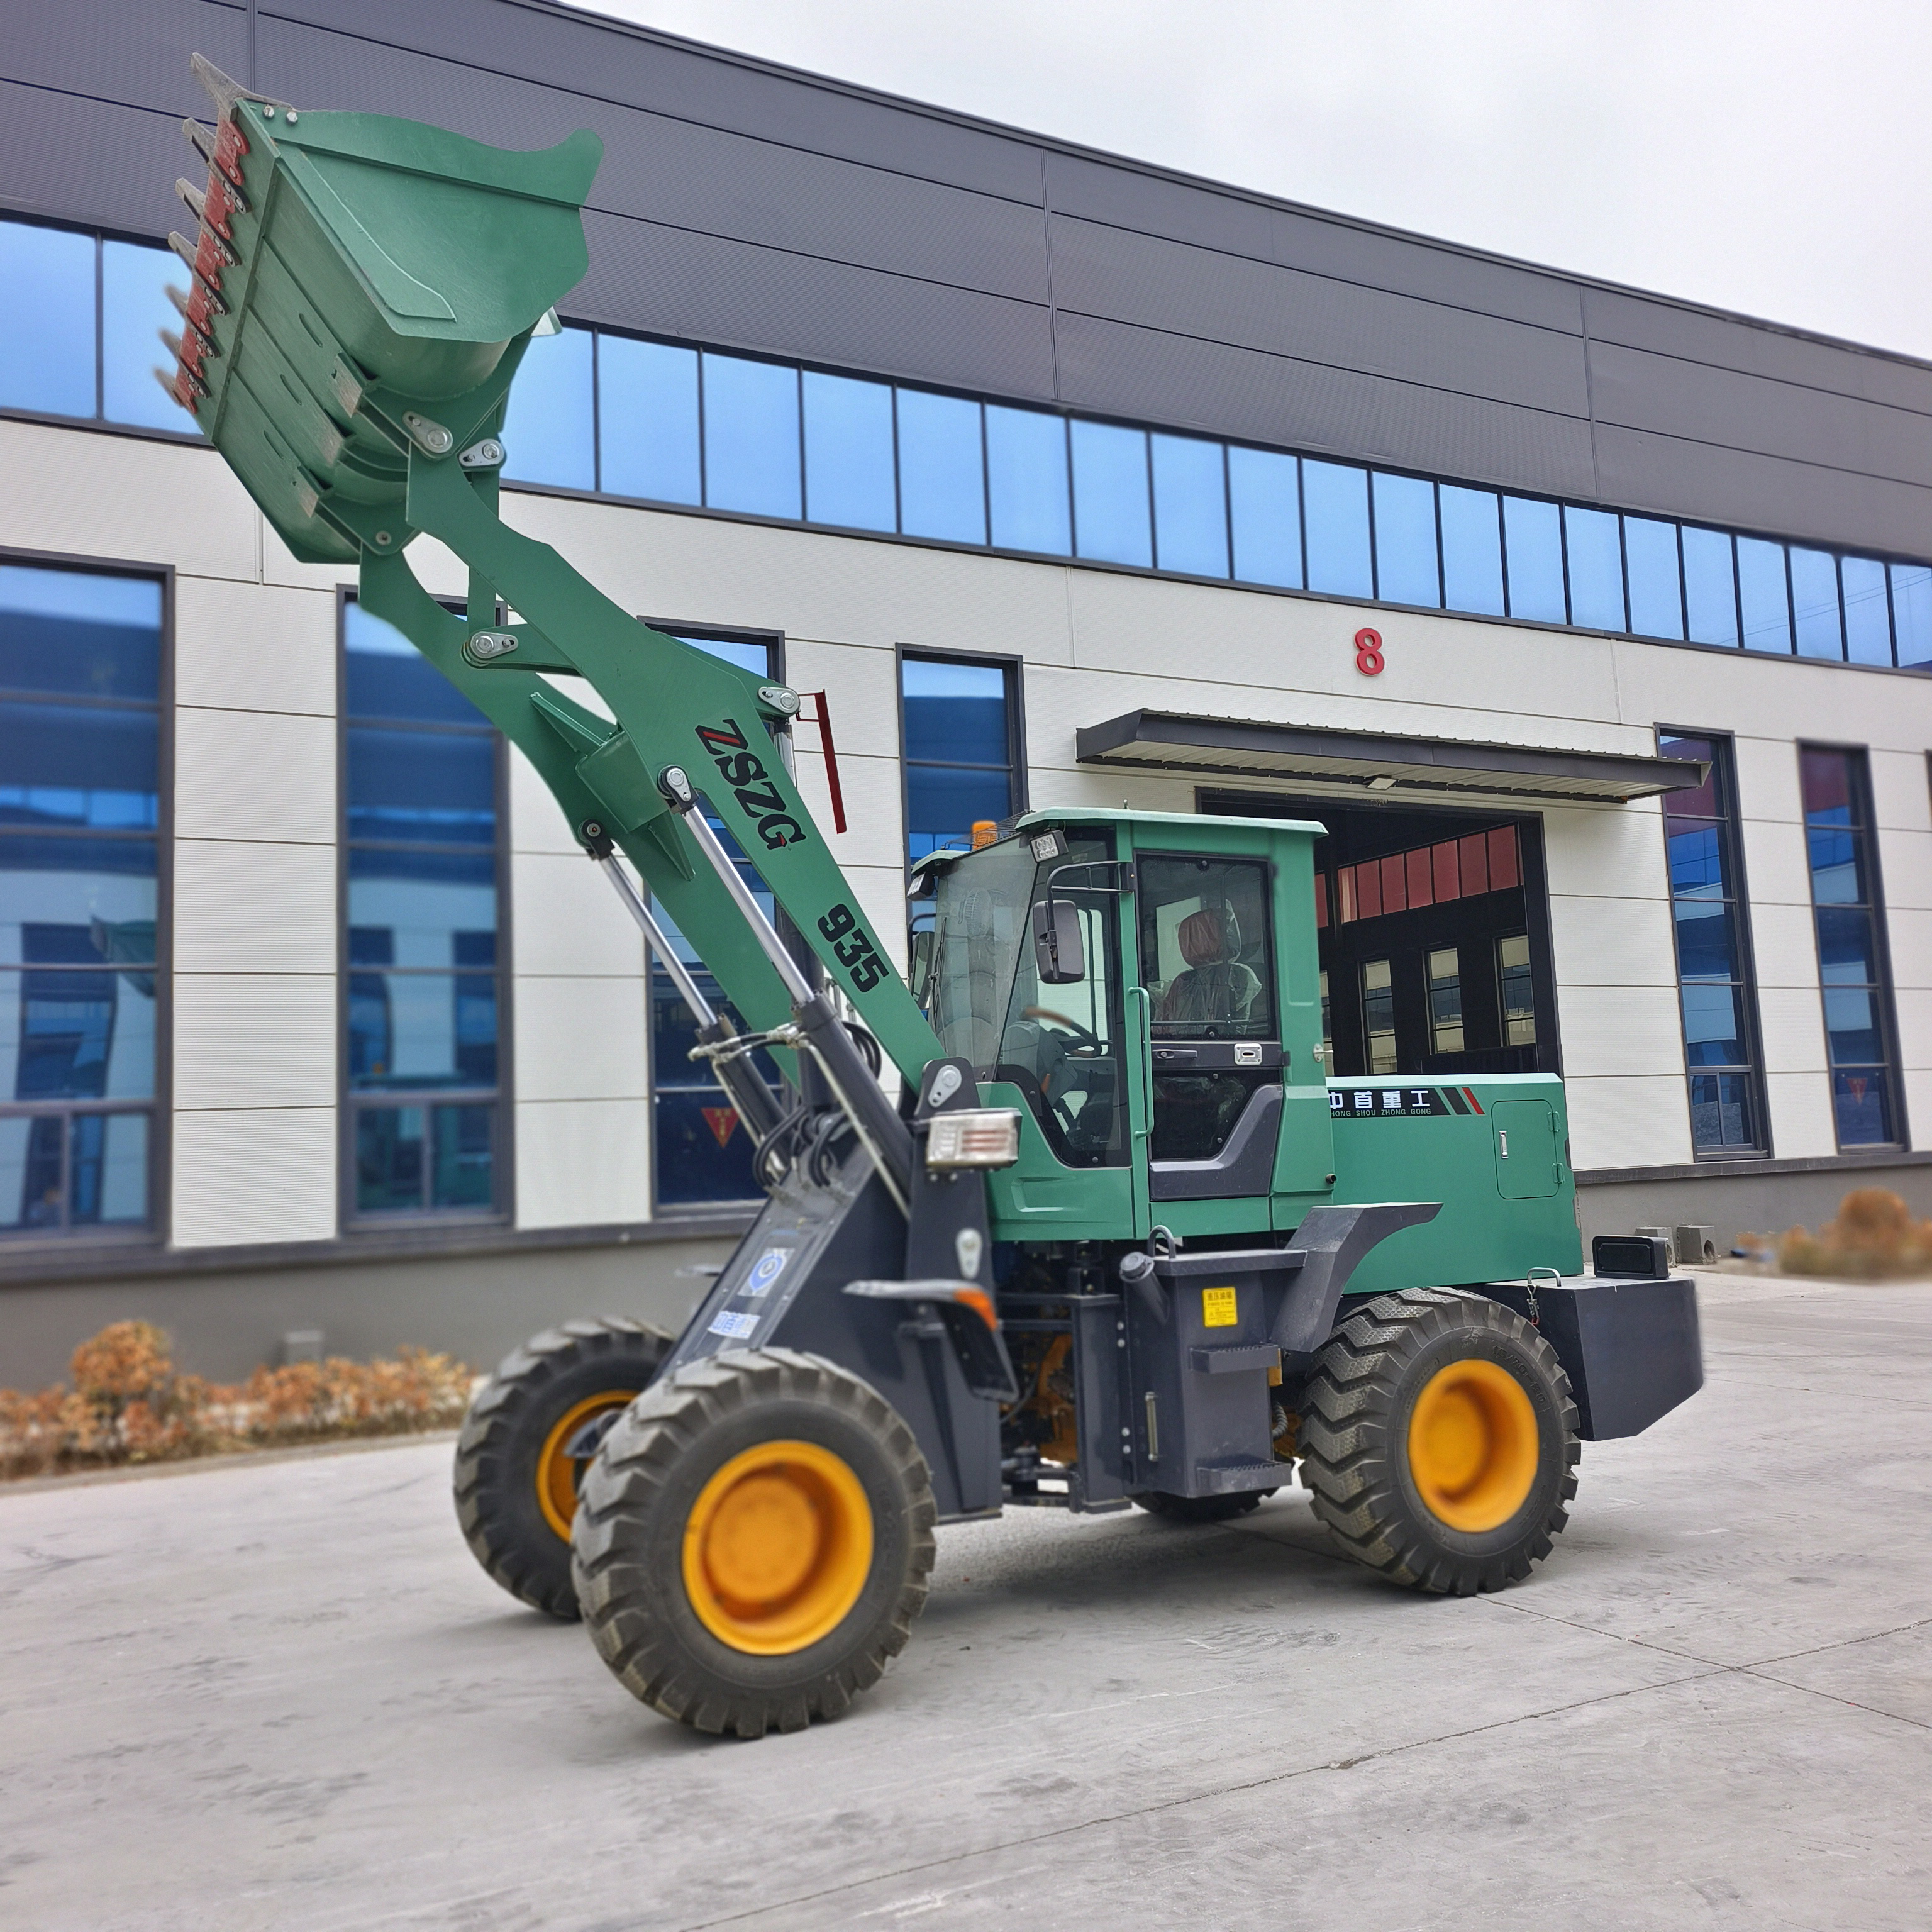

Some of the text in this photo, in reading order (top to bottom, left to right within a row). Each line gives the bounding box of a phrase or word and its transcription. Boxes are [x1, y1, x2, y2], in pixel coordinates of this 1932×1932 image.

[1354, 627, 1385, 675] 8
[695, 719, 806, 850] ZSZG
[818, 904, 889, 992] 935
[1328, 1090, 1430, 1109] 中首重工
